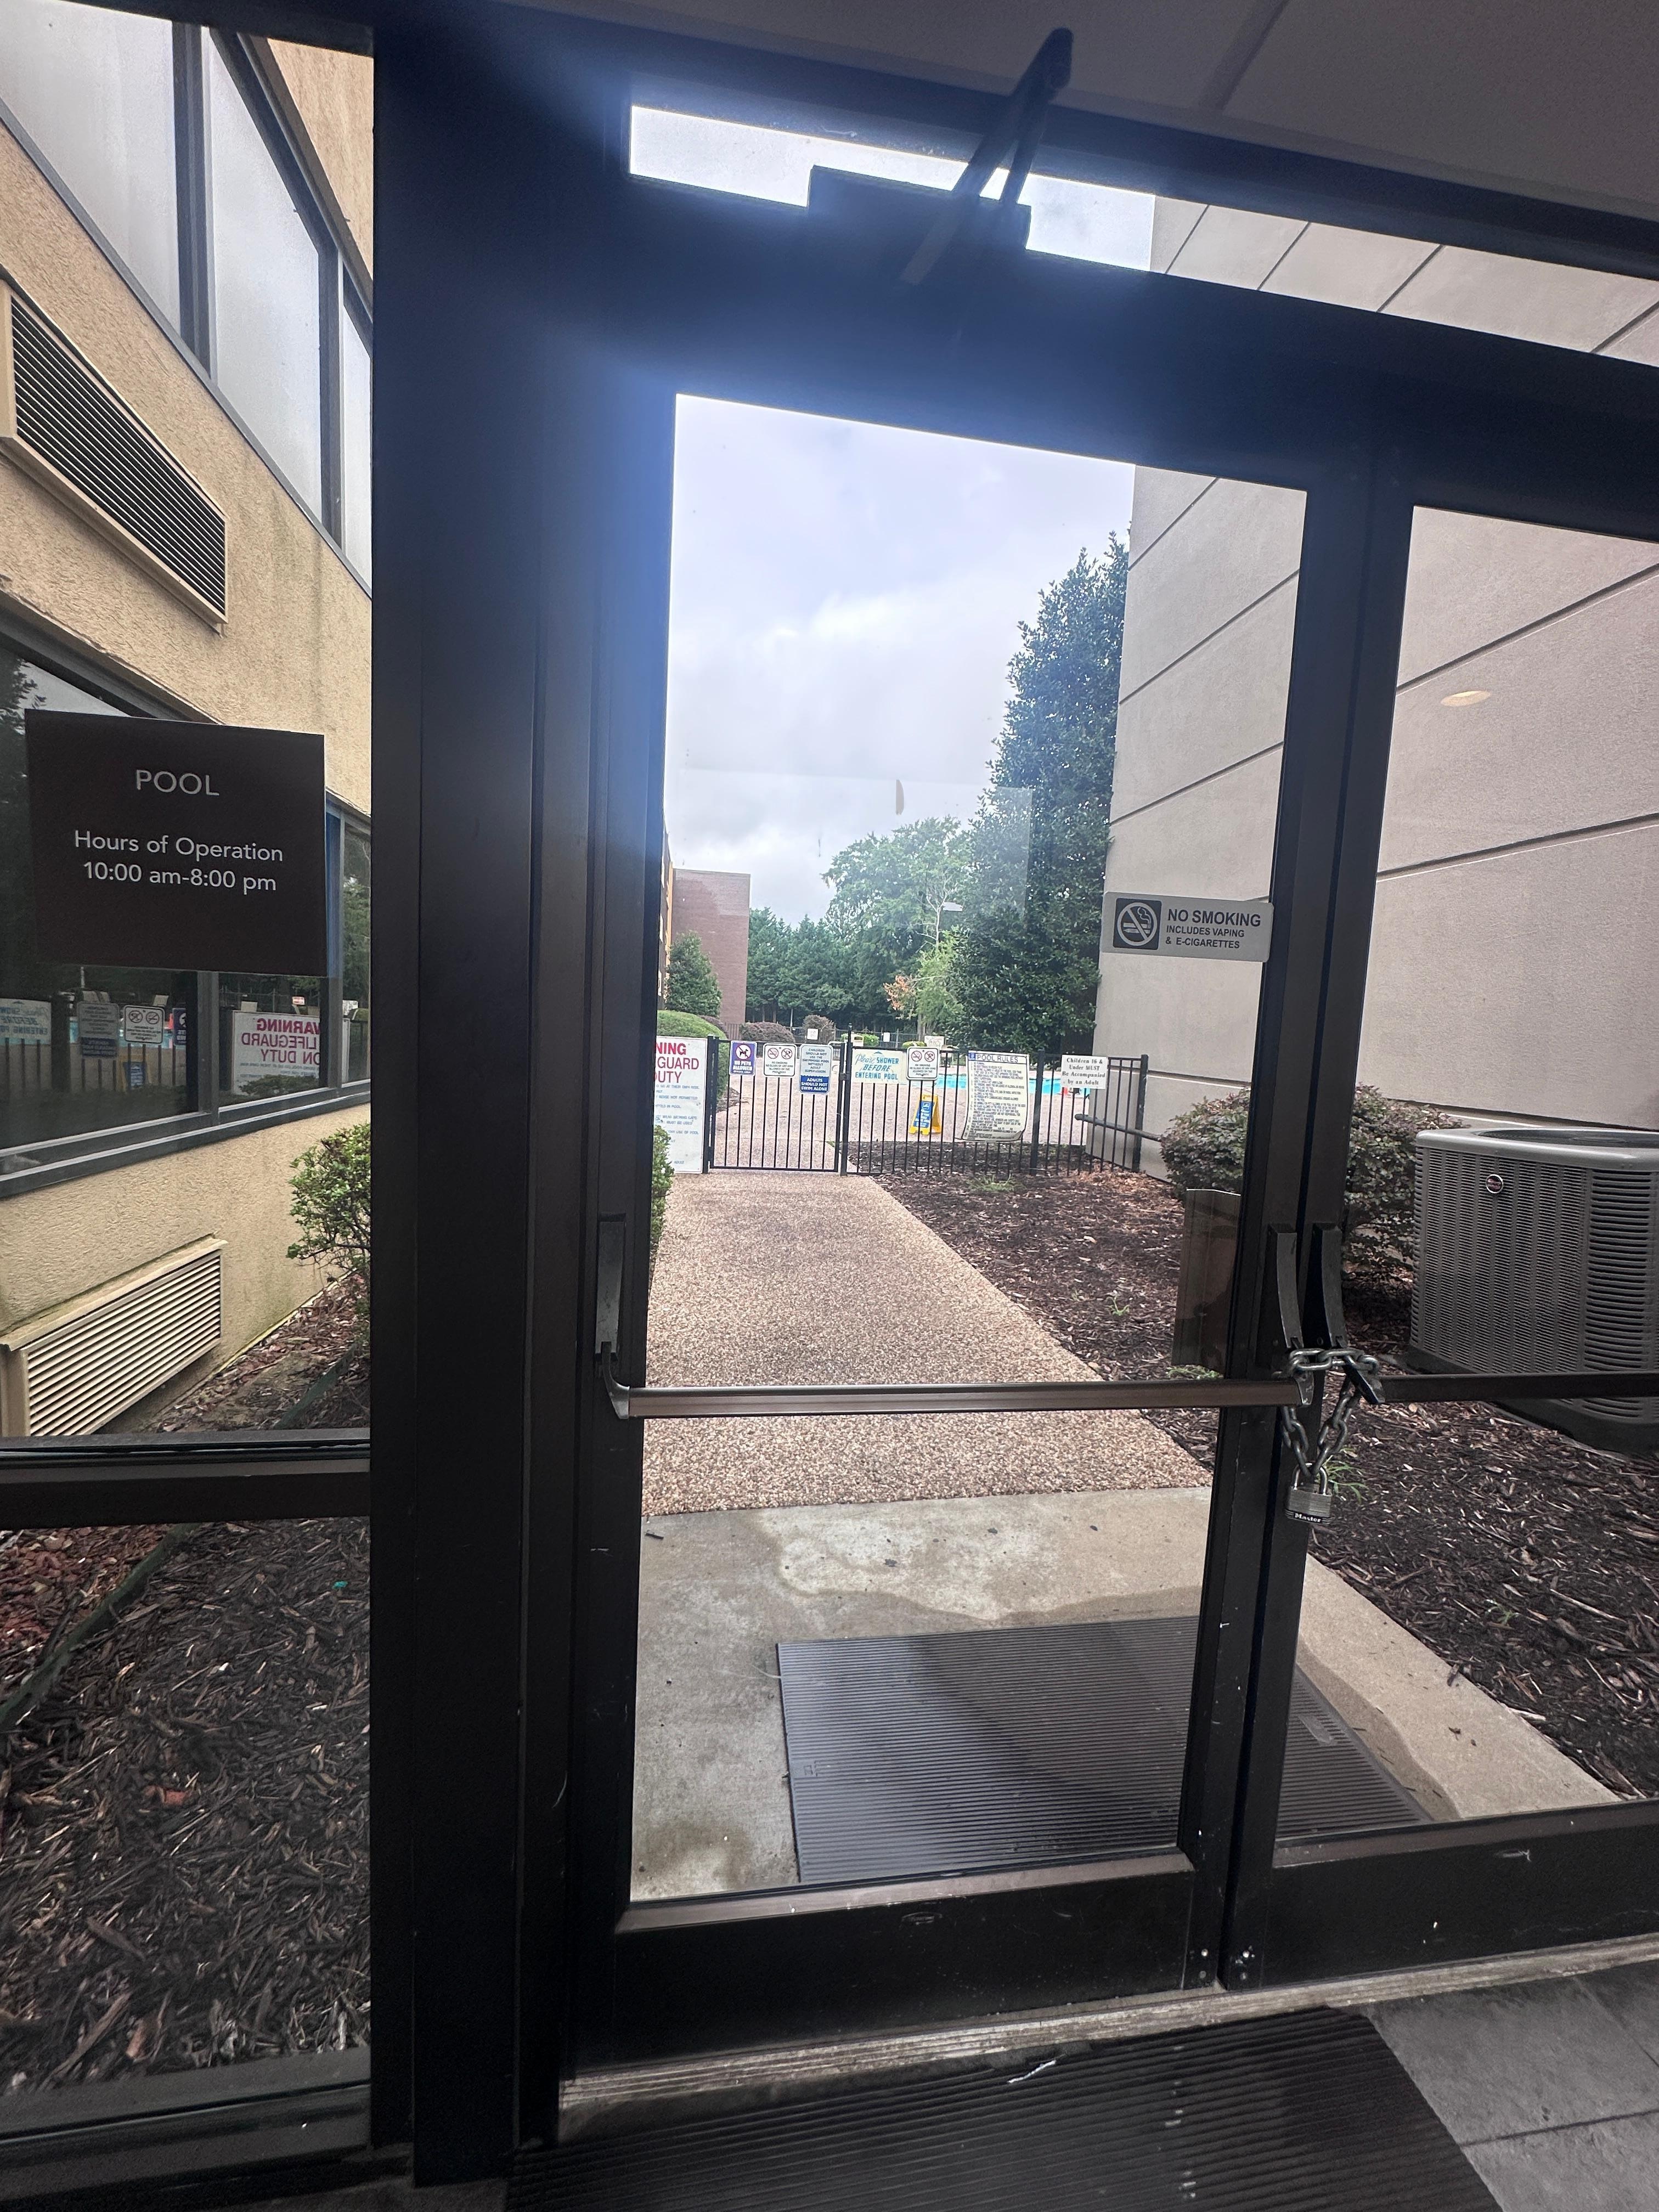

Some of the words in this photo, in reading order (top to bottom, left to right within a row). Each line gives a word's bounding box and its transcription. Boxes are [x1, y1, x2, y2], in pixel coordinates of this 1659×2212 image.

[137, 769, 219, 796] POOL
[75, 830, 139, 851] Hours
[146, 835, 169, 854] of
[176, 837, 283, 862] Operation
[83, 861, 142, 882] 10:00
[149, 868, 236, 888] am-8:00
[244, 877, 276, 895] pm
[1167, 909, 1189, 922] NO
[1192, 910, 1261, 927] SMOKING
[1166, 925, 1211, 936] INCLUDES
[1212, 928, 1245, 938] VAPING
[1165, 936, 1172, 945] &
[1176, 937, 1240, 949] E-CIGARETTES
[657, 1056, 699, 1070] GUARD
[862, 1064, 891, 1072] BEFORE
[654, 1070, 682, 1083] UTY
[1295, 1513, 1322, 1523] Master
